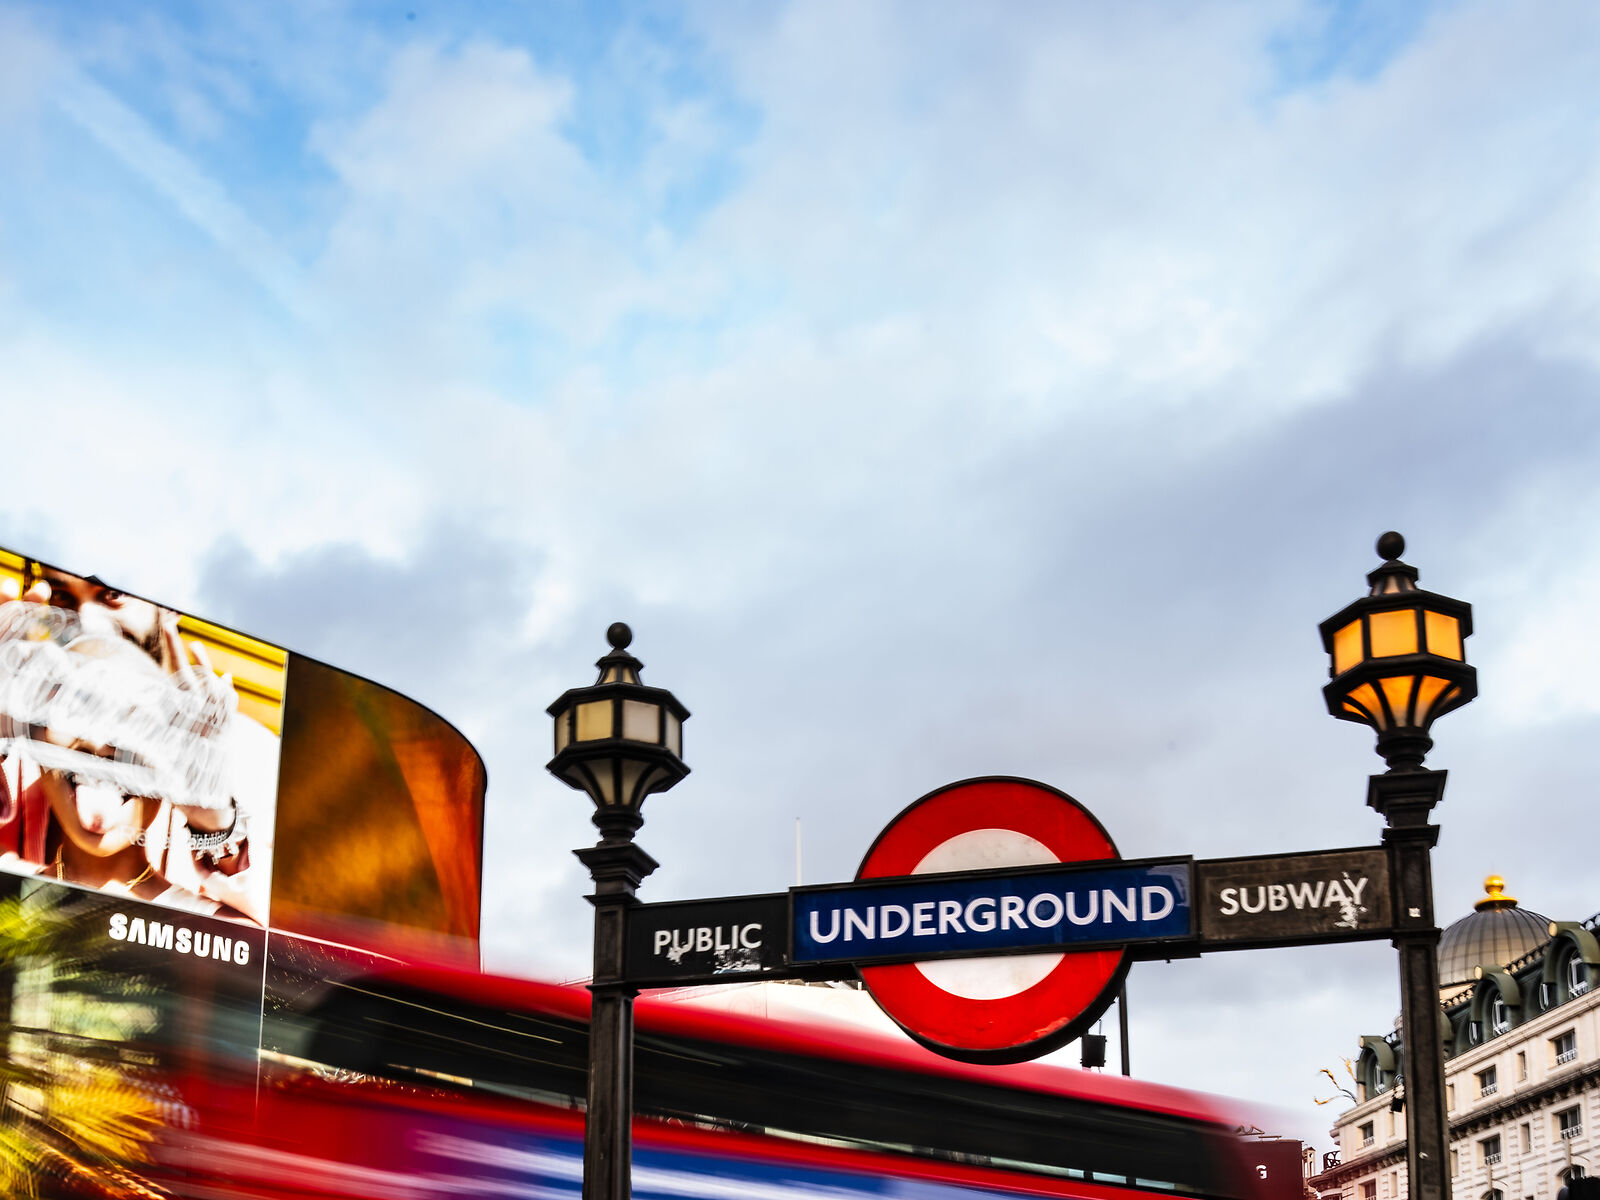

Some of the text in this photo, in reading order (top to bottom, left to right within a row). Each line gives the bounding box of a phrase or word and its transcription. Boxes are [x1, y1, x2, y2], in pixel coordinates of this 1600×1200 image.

[808, 884, 1175, 945] UNDERGROUND
[1219, 876, 1369, 917] SUBWAY
[108, 912, 250, 966] SAMSUNG
[653, 922, 763, 957] PUBLIC
